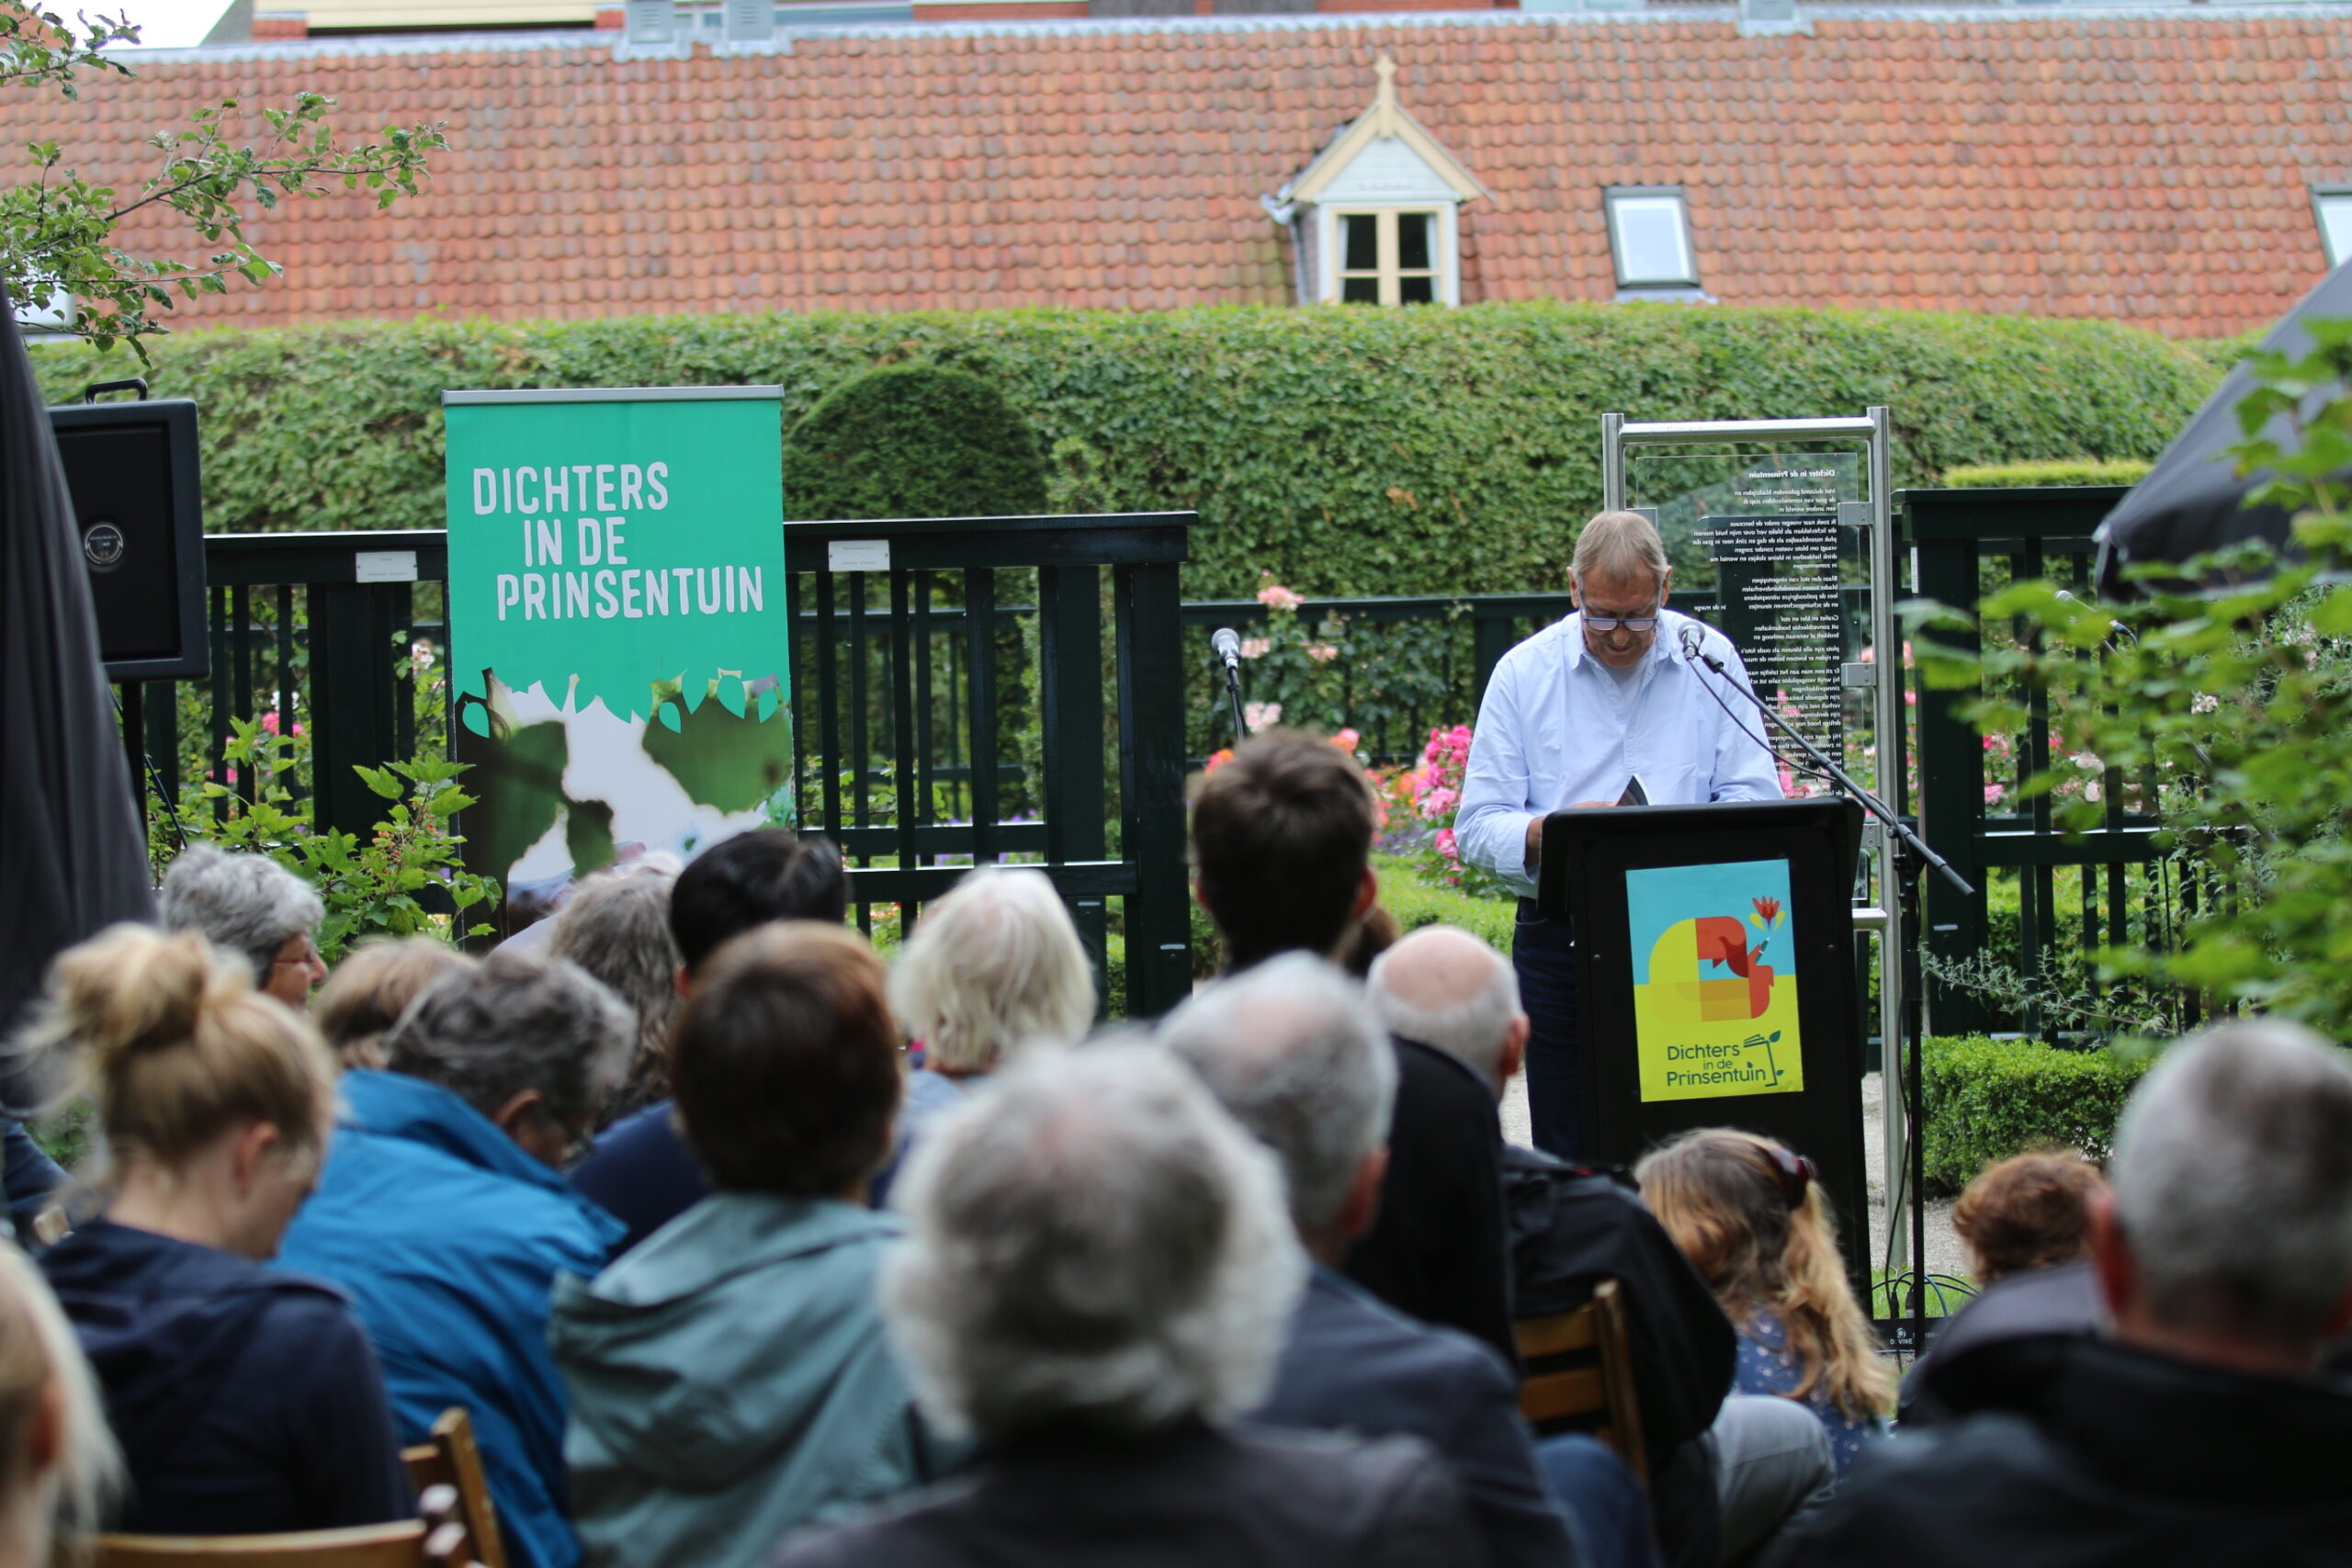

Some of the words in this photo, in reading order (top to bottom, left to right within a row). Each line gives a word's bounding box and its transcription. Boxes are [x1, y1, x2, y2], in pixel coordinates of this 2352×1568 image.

[473, 461, 669, 514] DICHTERS
[524, 519, 562, 567] IN
[578, 516, 628, 566] DE
[497, 565, 763, 621] PRINSENTUIN
[1667, 1043, 1740, 1060] Dichters
[1703, 1059, 1713, 1070] in
[1717, 1059, 1733, 1069] de
[1667, 1067, 1766, 1086] Prinsentuin
